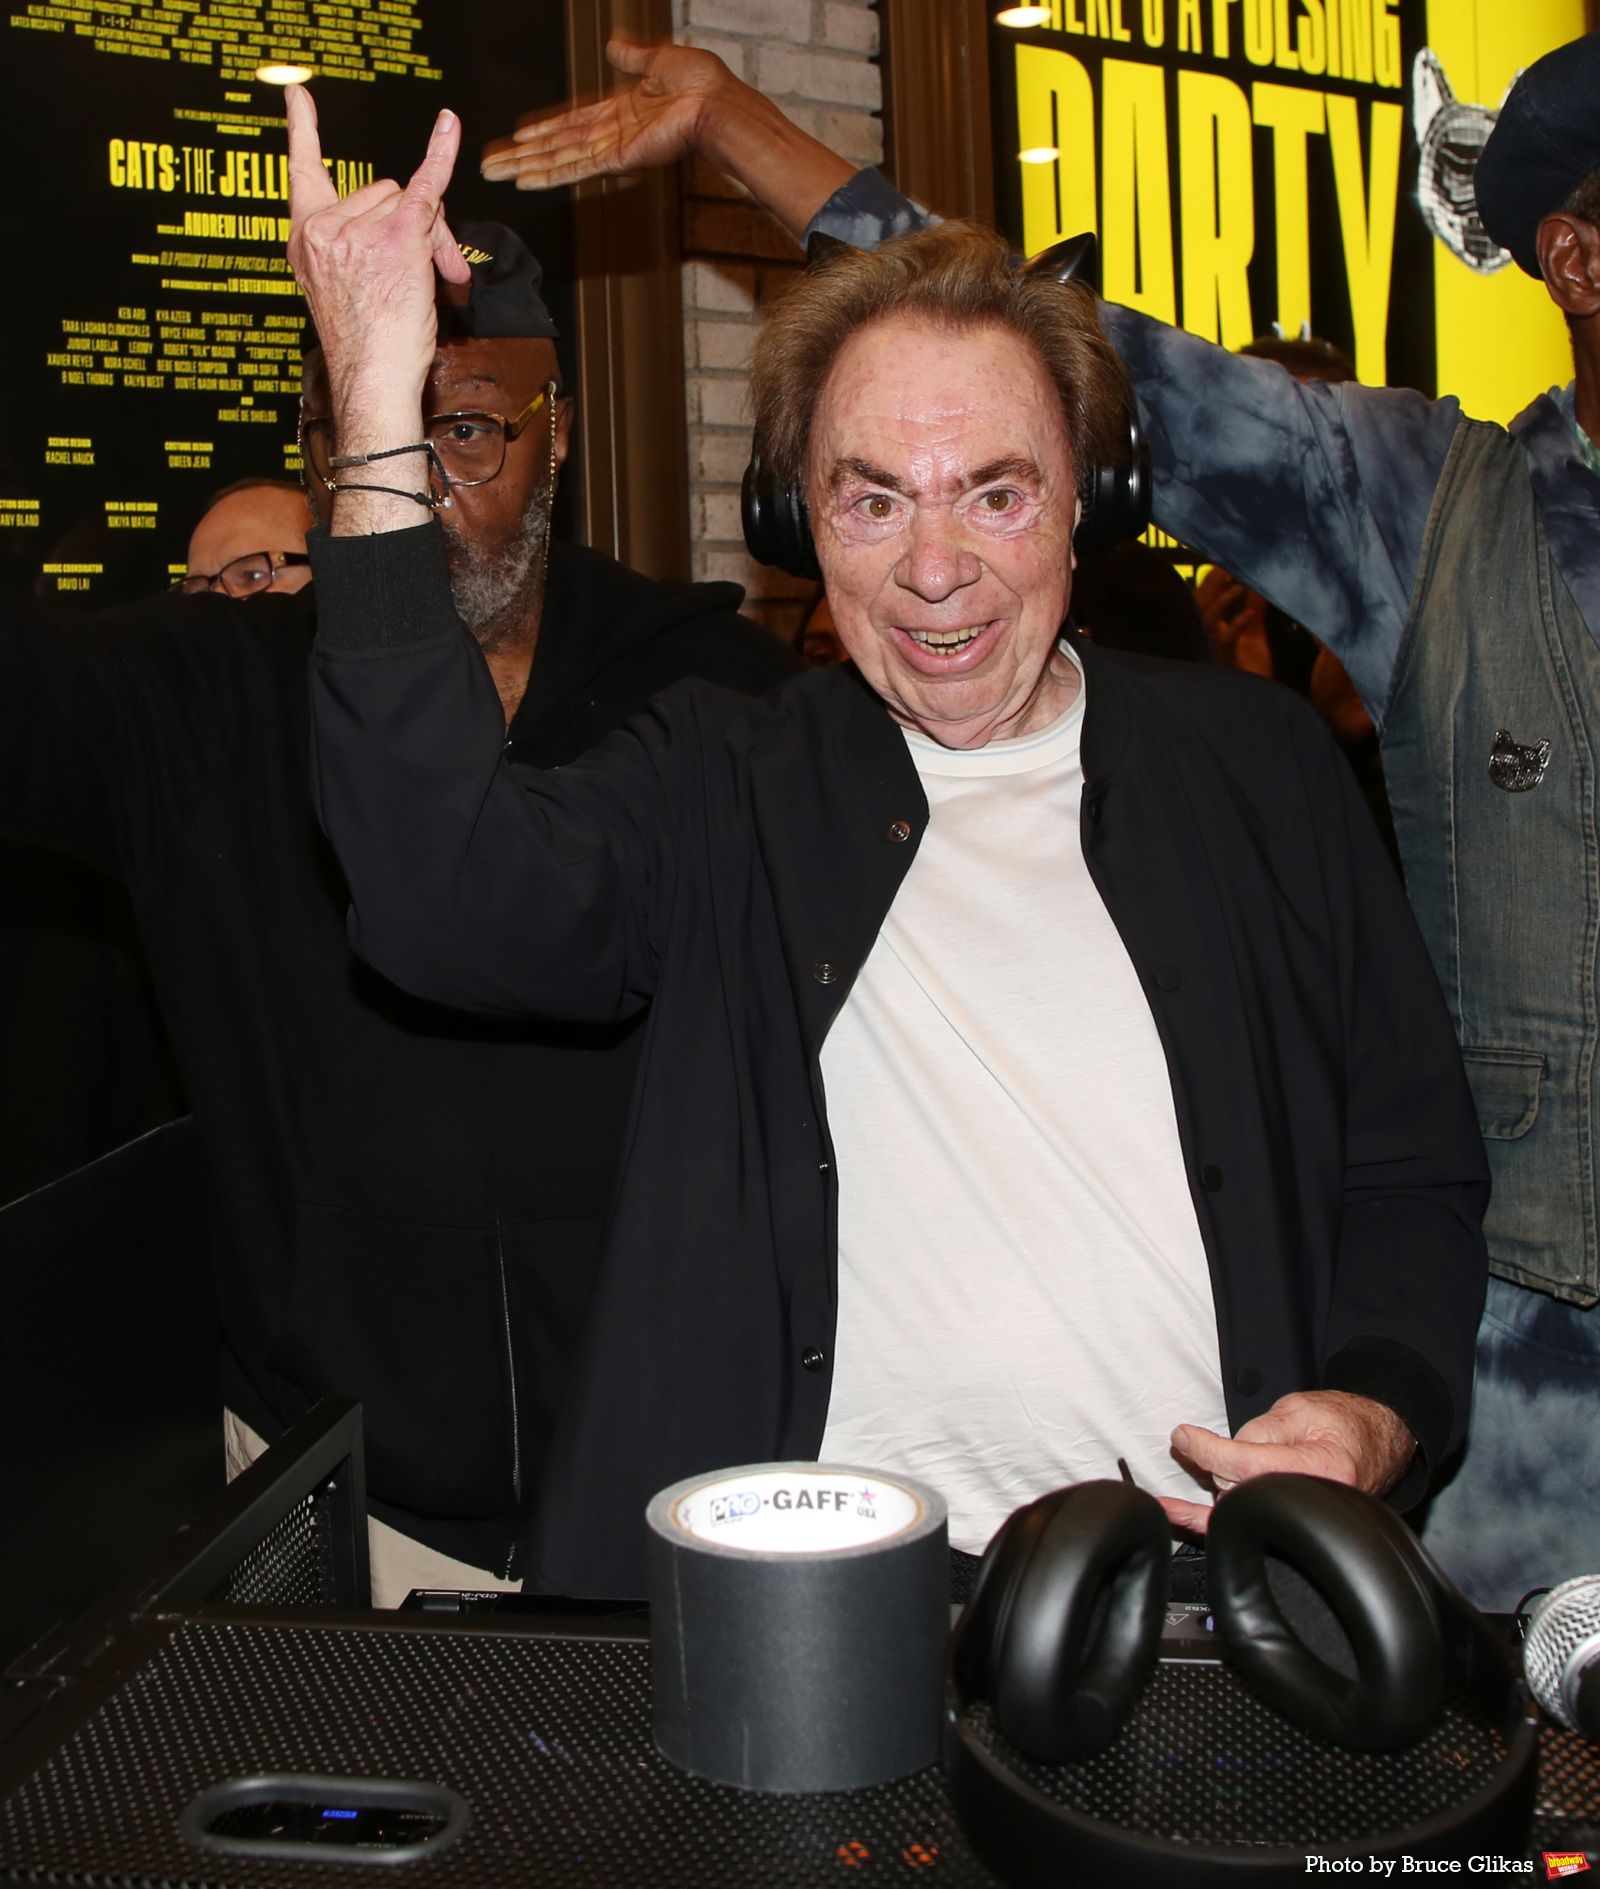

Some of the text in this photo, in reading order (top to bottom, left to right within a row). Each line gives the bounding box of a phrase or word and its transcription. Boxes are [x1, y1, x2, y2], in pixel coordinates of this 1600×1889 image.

[109, 139, 180, 192] CATS:
[183, 147, 216, 195] THE
[220, 151, 332, 200] JELLI
[185, 211, 236, 238] ANDREW
[238, 215, 276, 241] LLOYD
[1015, 43, 1403, 386] PARTY
